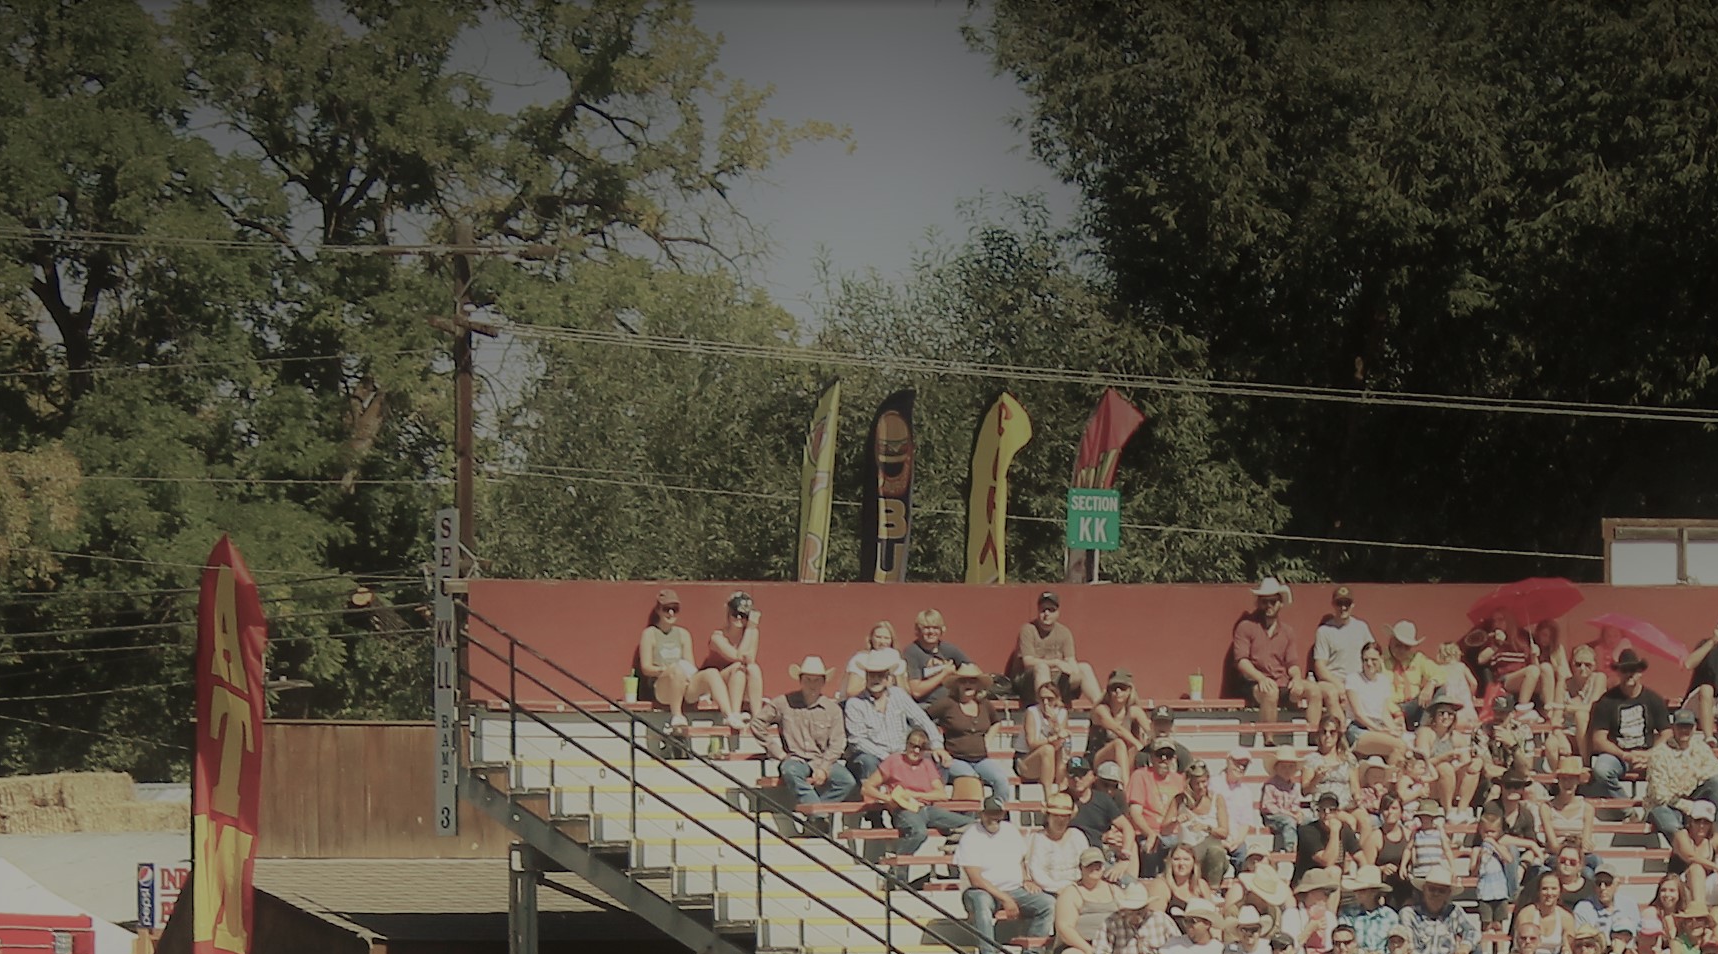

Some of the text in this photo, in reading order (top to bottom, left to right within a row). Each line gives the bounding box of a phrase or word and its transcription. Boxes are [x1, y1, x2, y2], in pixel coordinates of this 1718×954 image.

[1070, 495, 1119, 512] SECTION
[1079, 516, 1108, 543] KK
[438, 661, 452, 690] LL
[441, 715, 450, 784] RAMP
[441, 806, 451, 829] 3
